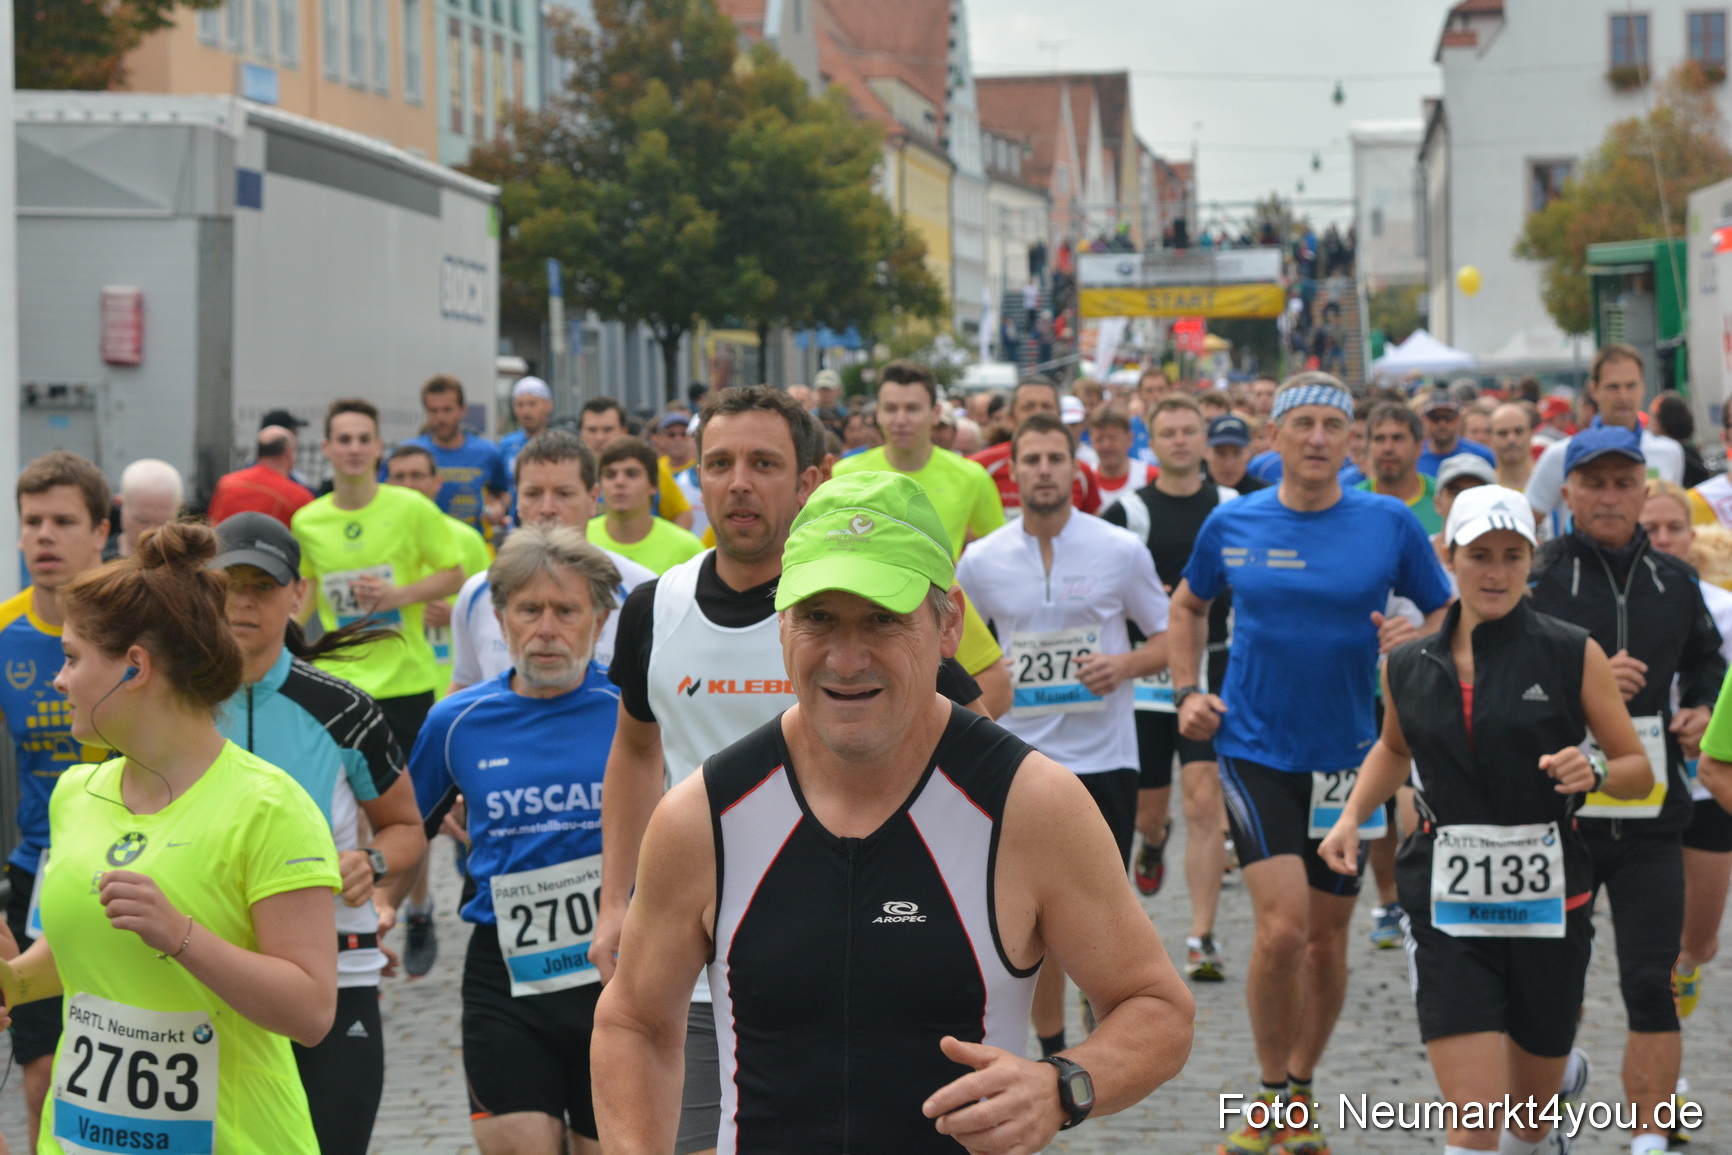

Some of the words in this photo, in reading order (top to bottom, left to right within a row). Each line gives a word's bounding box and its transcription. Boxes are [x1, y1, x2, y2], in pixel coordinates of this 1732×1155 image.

[1147, 292, 1214, 309] START
[495, 885, 535, 900] PARTL
[537, 869, 599, 893] Neumarkt
[1448, 854, 1551, 896] 2133
[1469, 907, 1528, 920] Kerstin
[69, 1005, 104, 1031] PARTL
[107, 1018, 186, 1043] Neumarkt
[66, 1035, 199, 1112] 2763
[78, 1115, 169, 1150] Vanessa
